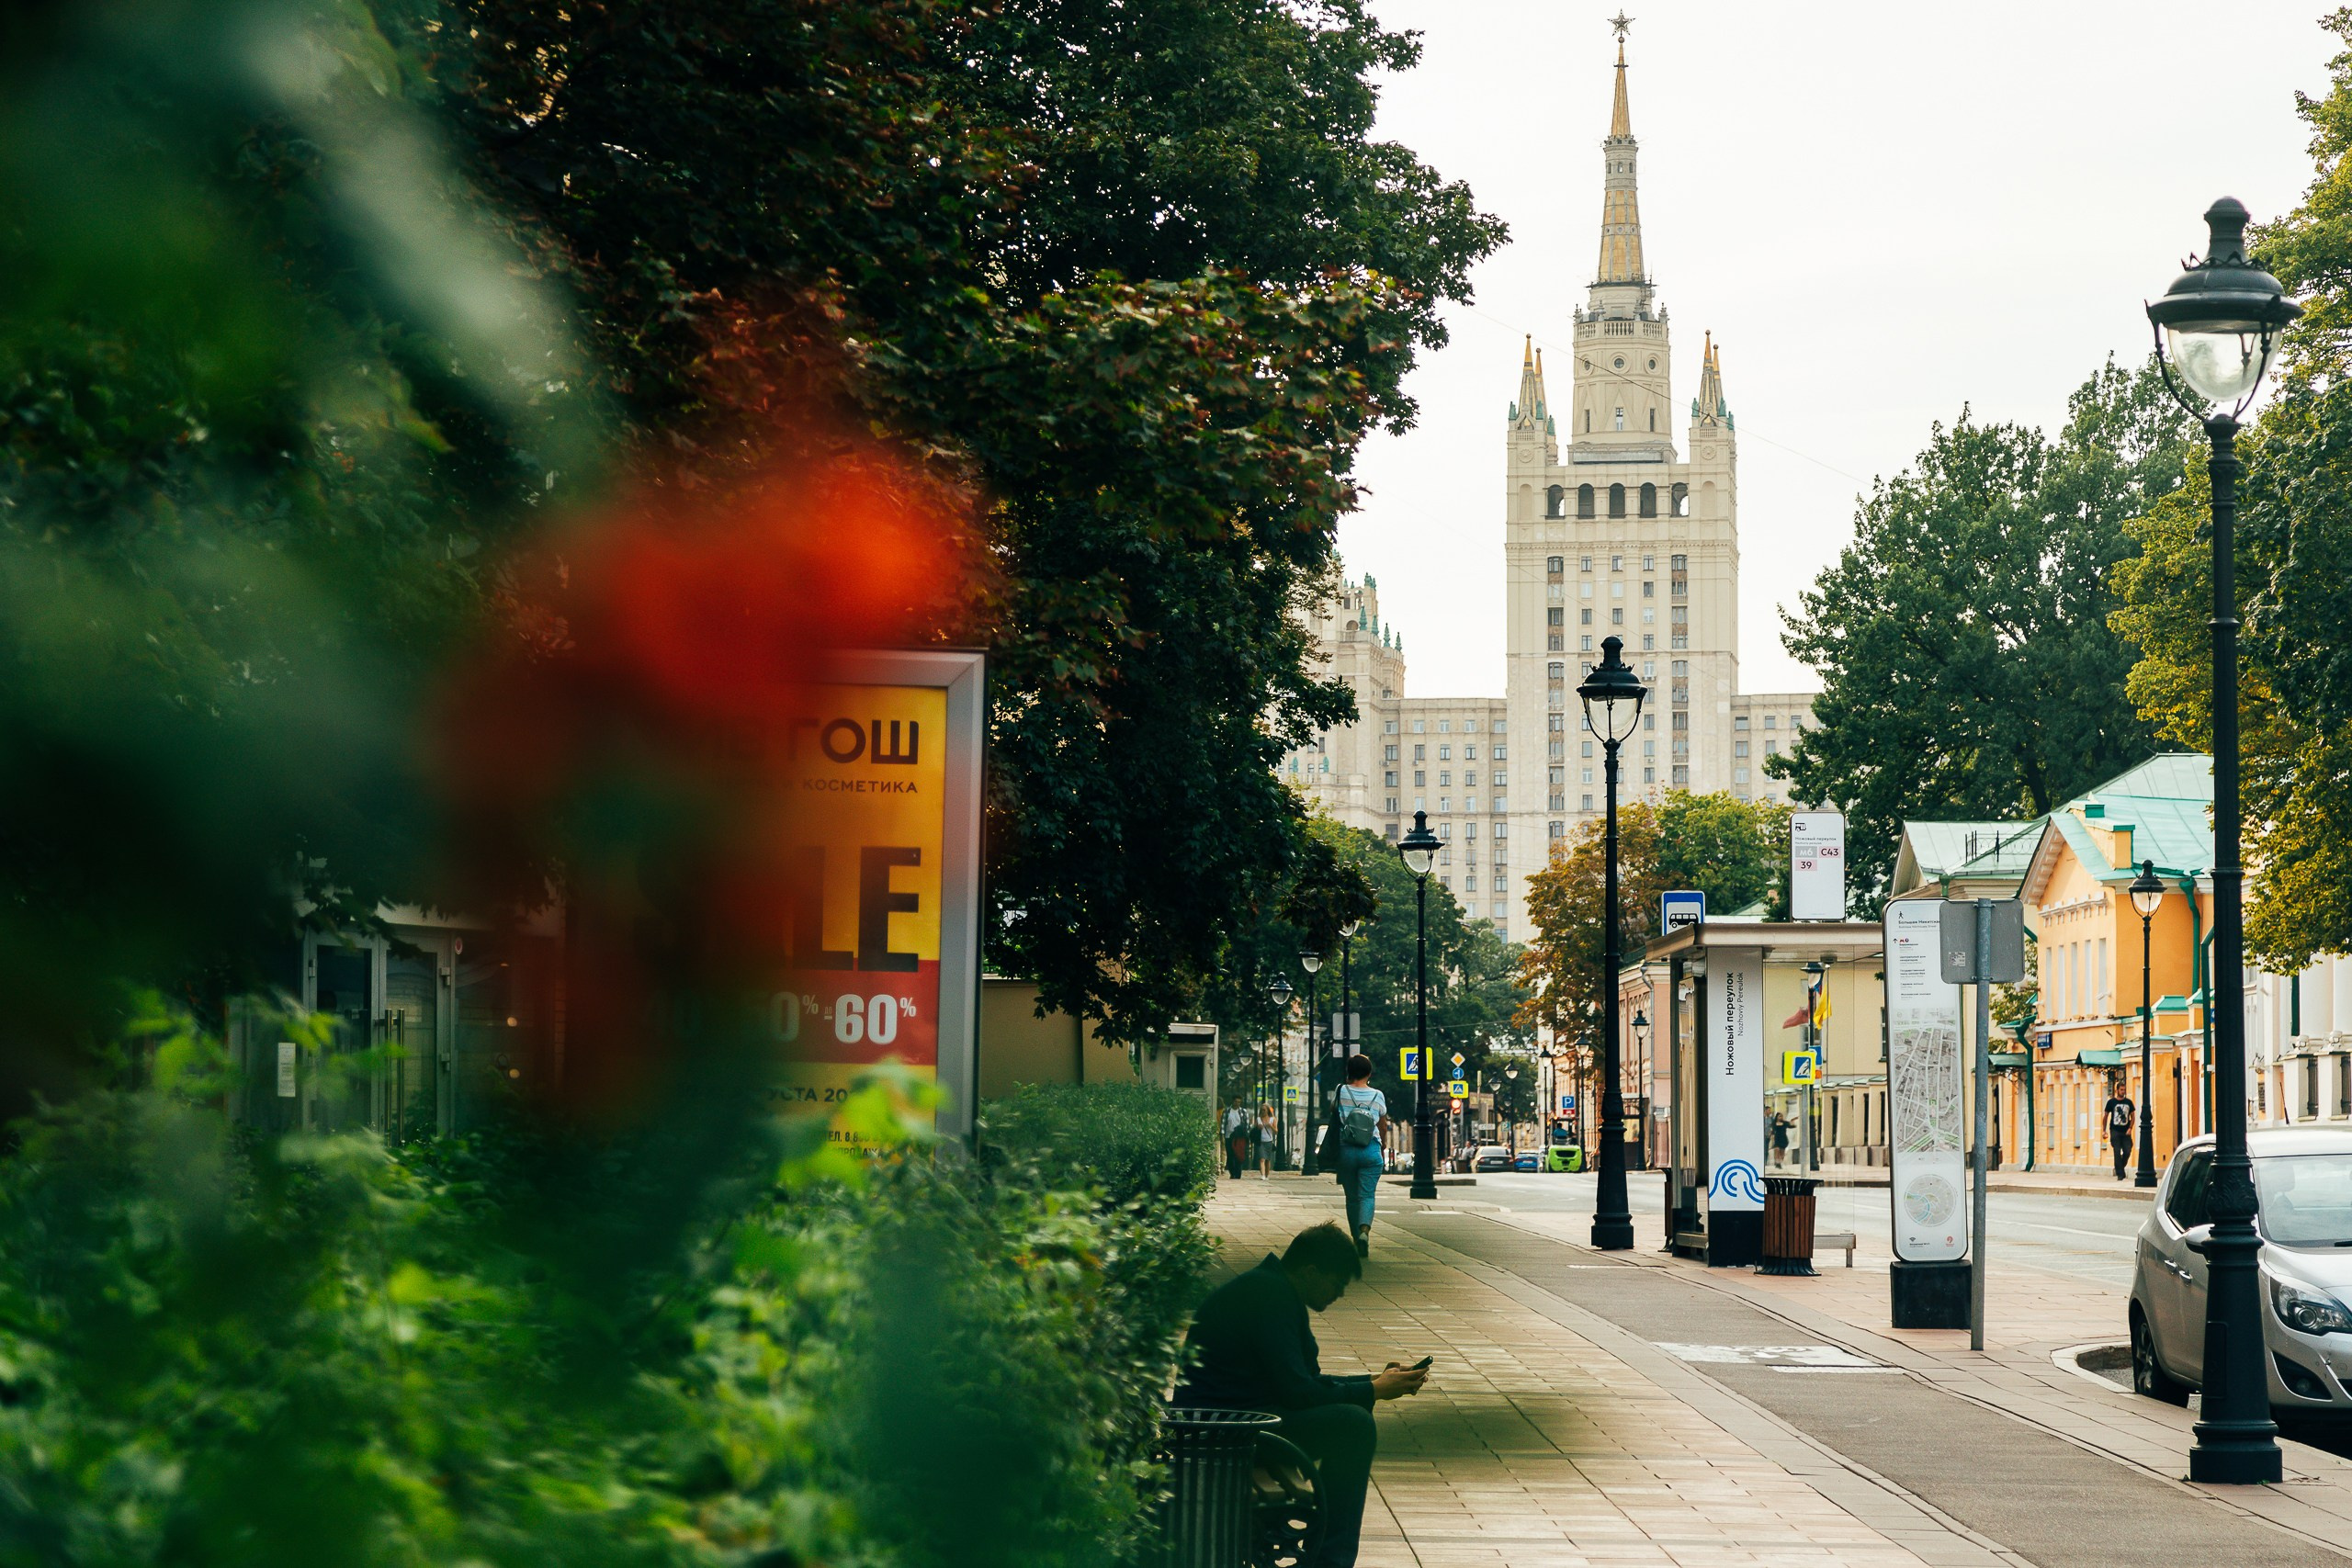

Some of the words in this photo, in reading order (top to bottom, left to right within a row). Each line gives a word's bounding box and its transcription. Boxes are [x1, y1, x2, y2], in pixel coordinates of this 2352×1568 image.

[788, 717, 920, 765] ГОШ
[802, 779, 918, 794] КОСМЕТИКА
[1800, 861, 1813, 869] 39
[1726, 972, 1736, 1023] переулок
[1725, 1025, 1735, 1076] Ножовый
